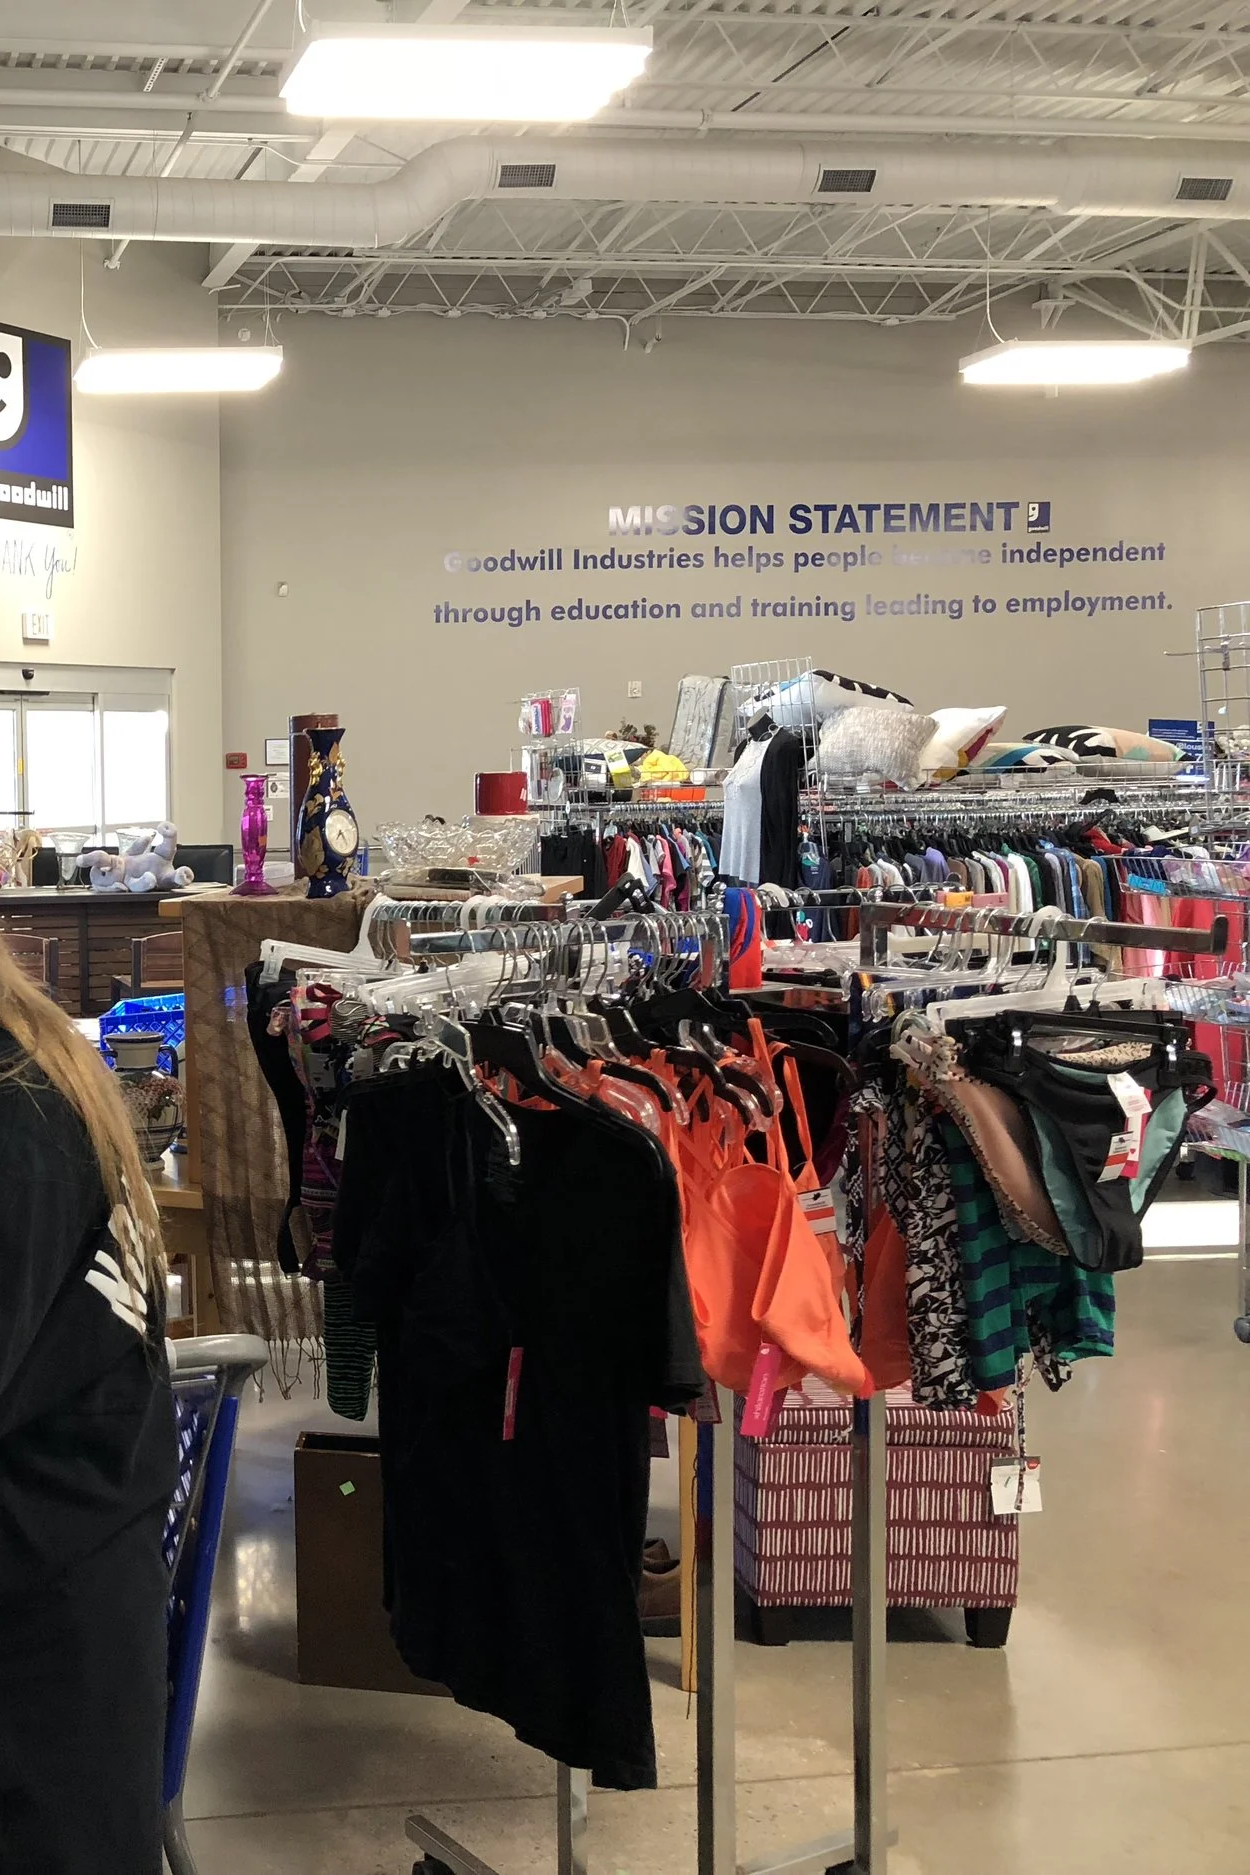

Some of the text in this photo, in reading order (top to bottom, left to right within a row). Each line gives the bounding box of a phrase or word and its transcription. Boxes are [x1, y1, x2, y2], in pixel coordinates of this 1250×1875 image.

[608, 504, 775, 537] MISSION
[789, 501, 1020, 534] STATEMENT
[442, 548, 563, 575] Goodwill
[573, 547, 705, 571] Industries
[713, 545, 785, 574] helps
[794, 545, 882, 573] people
[1001, 540, 1166, 568] independent
[31, 613, 50, 636] EXIT
[434, 590, 1174, 628] through education and training leading to employment.
